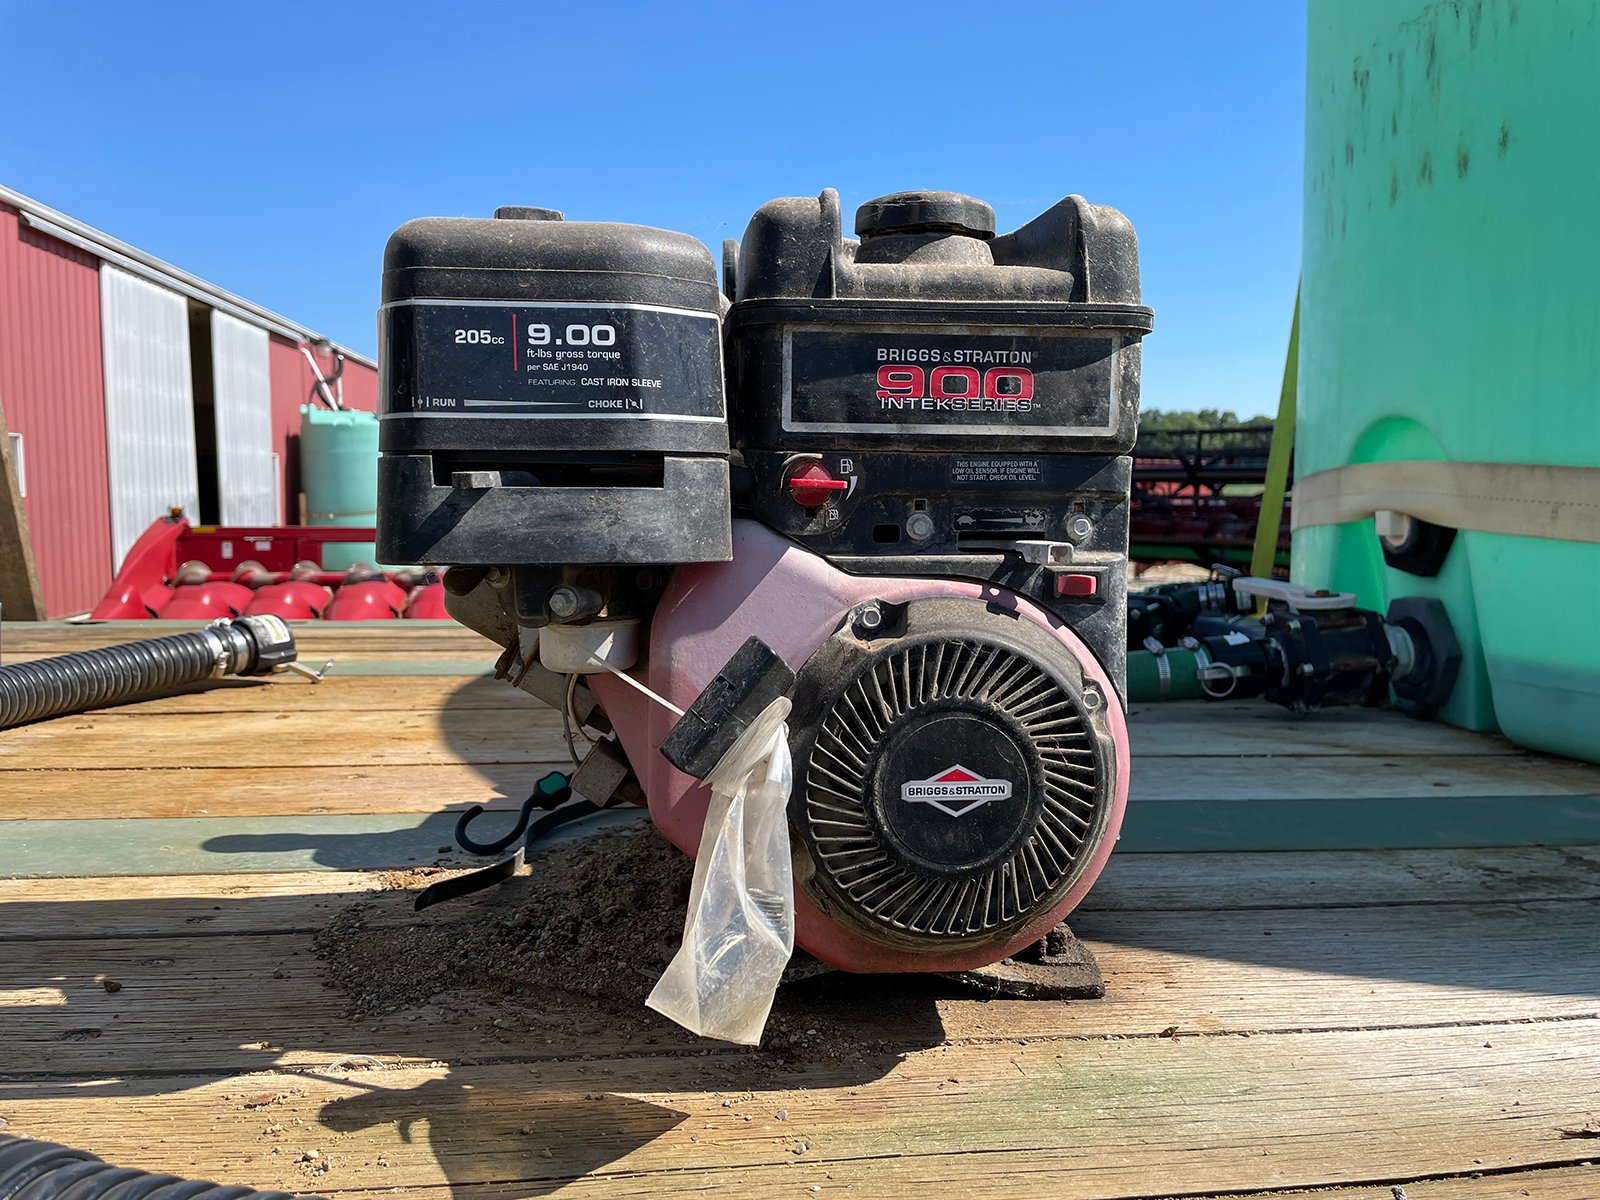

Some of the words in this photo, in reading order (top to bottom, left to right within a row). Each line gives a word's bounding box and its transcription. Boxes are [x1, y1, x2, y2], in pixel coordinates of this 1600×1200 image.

[454, 329, 505, 345] 205cc
[527, 323, 616, 346] 9.00
[526, 349, 552, 358] ft-lbs
[555, 350, 584, 359] gross
[587, 350, 621, 359] torque
[527, 364, 541, 372] per
[543, 363, 559, 371] SAE
[561, 363, 589, 371] J1940
[581, 378, 604, 386] CAST
[607, 378, 629, 386] IRON
[631, 379, 662, 388] SLEEVE
[876, 364, 1035, 402] 900
[432, 398, 456, 407] RUN
[588, 400, 623, 408] CHOKE
